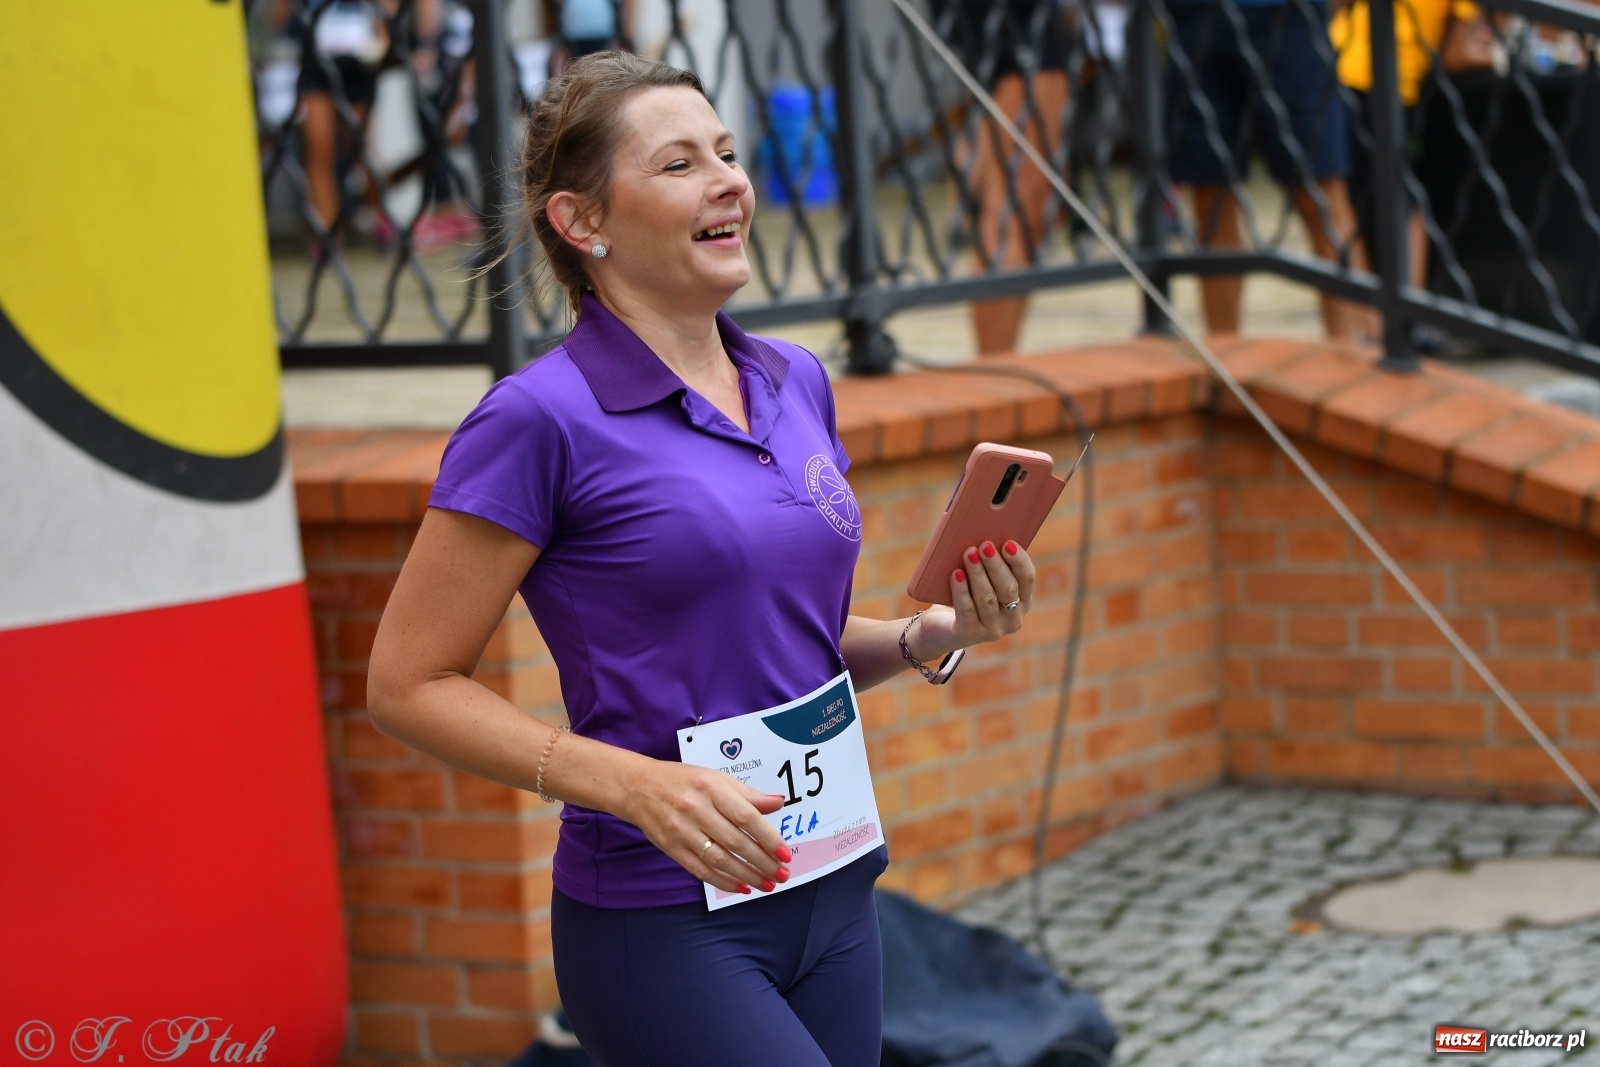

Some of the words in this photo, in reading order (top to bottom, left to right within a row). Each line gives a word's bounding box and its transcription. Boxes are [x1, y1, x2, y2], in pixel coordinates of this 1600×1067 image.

[808, 459, 823, 493] SWEDISH
[818, 500, 853, 536] QUALITY
[826, 701, 837, 715] BIEG
[836, 698, 844, 709] PO
[777, 748, 824, 807] 15
[780, 810, 820, 841] ELA
